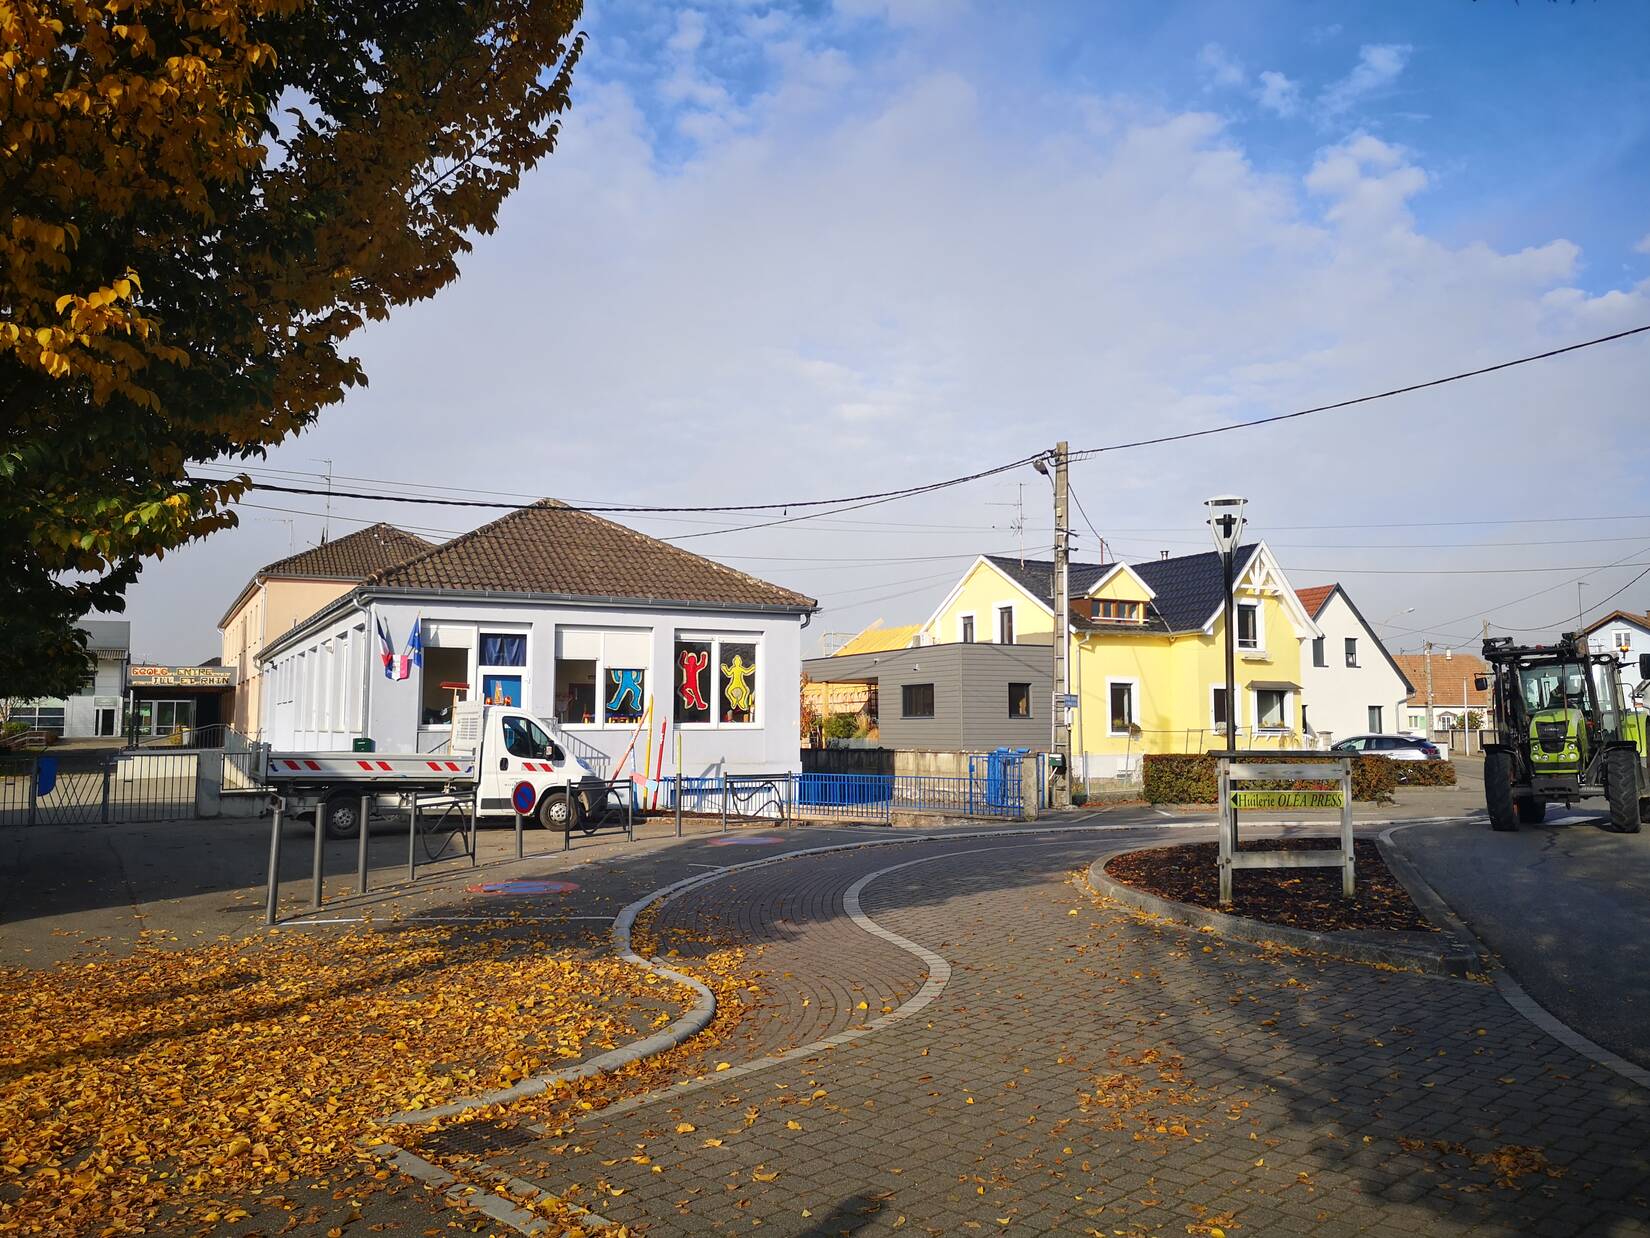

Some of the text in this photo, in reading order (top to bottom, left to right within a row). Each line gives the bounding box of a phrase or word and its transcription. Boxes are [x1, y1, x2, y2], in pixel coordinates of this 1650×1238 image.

[176, 667, 213, 676] ENTRE
[180, 677, 195, 685] ET
[201, 677, 229, 685] RHIN
[1239, 794, 1275, 807] Huilerie
[1310, 794, 1342, 807] PRESS
